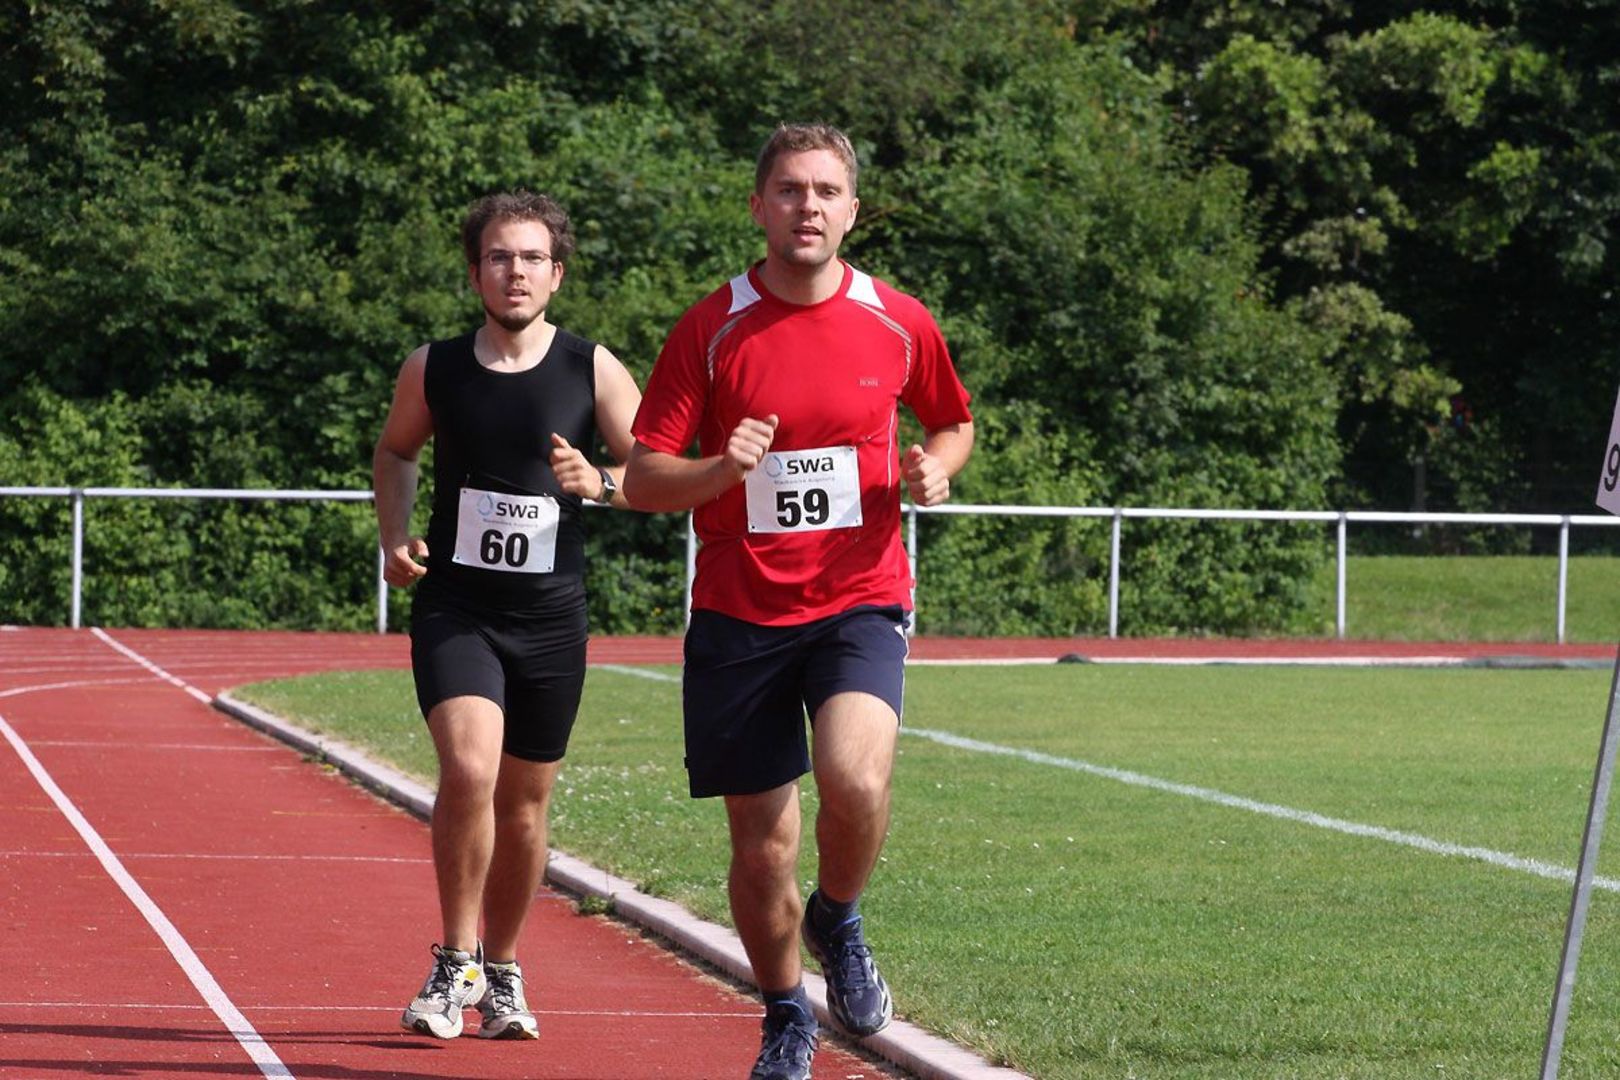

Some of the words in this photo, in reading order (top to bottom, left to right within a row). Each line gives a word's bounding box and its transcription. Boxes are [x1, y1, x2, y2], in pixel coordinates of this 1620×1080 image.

[787, 456, 834, 475] swa
[496, 502, 538, 519] swa
[777, 488, 829, 527] 59
[480, 529, 529, 567] 60
